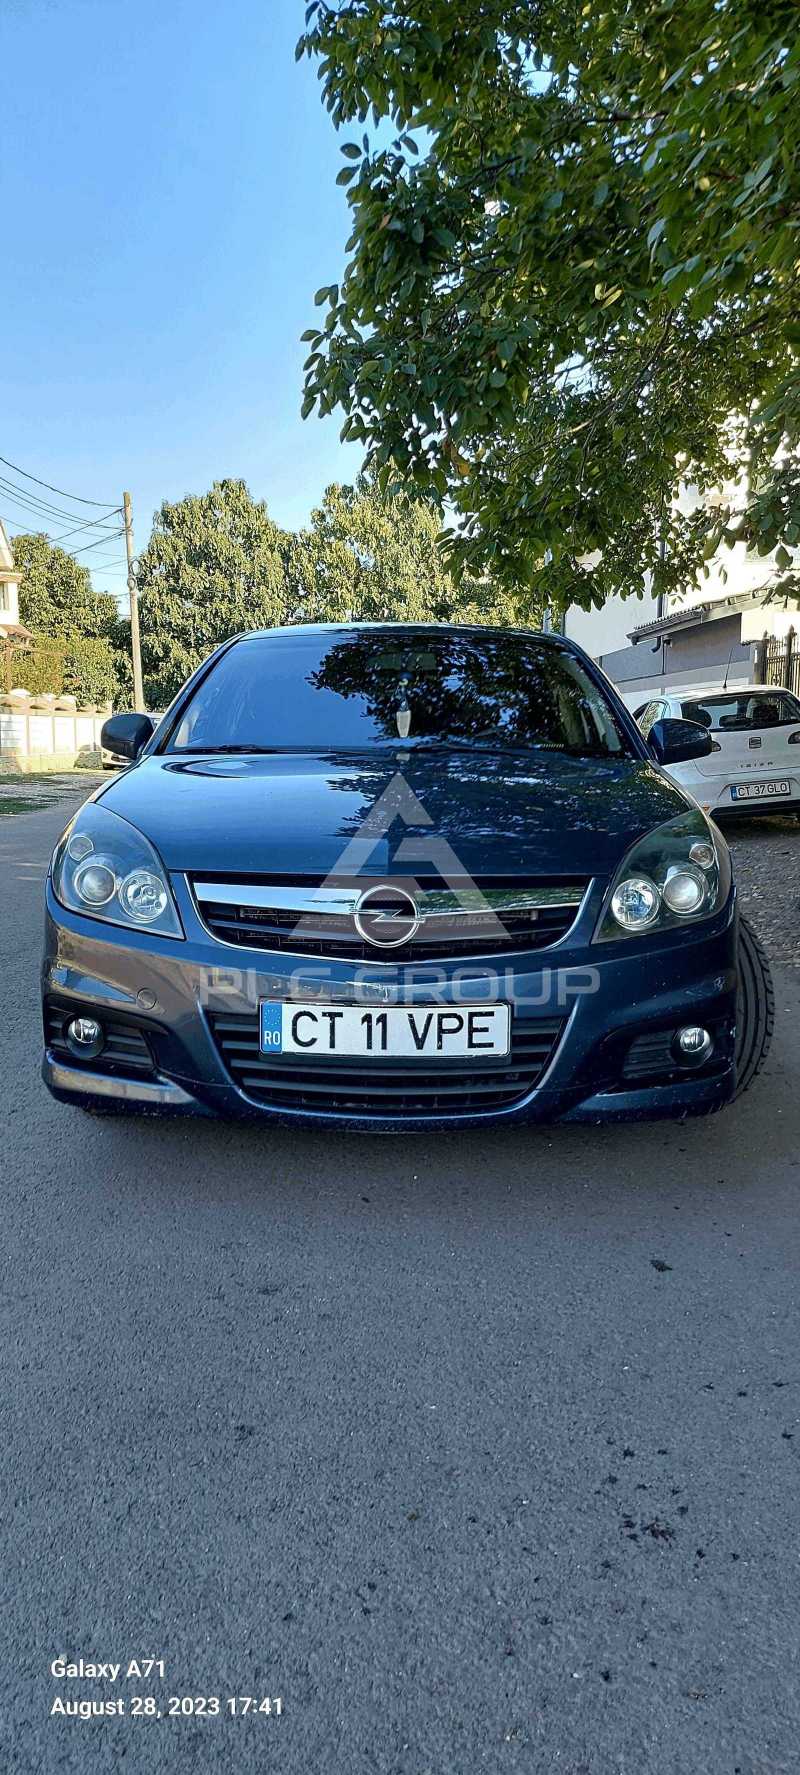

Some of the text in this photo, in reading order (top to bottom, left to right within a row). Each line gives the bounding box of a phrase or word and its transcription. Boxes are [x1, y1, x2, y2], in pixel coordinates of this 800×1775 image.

[738, 783, 787, 796] CT 37 GLO
[263, 1030, 281, 1046] RO
[291, 1010, 495, 1051] CT 11 VPE
